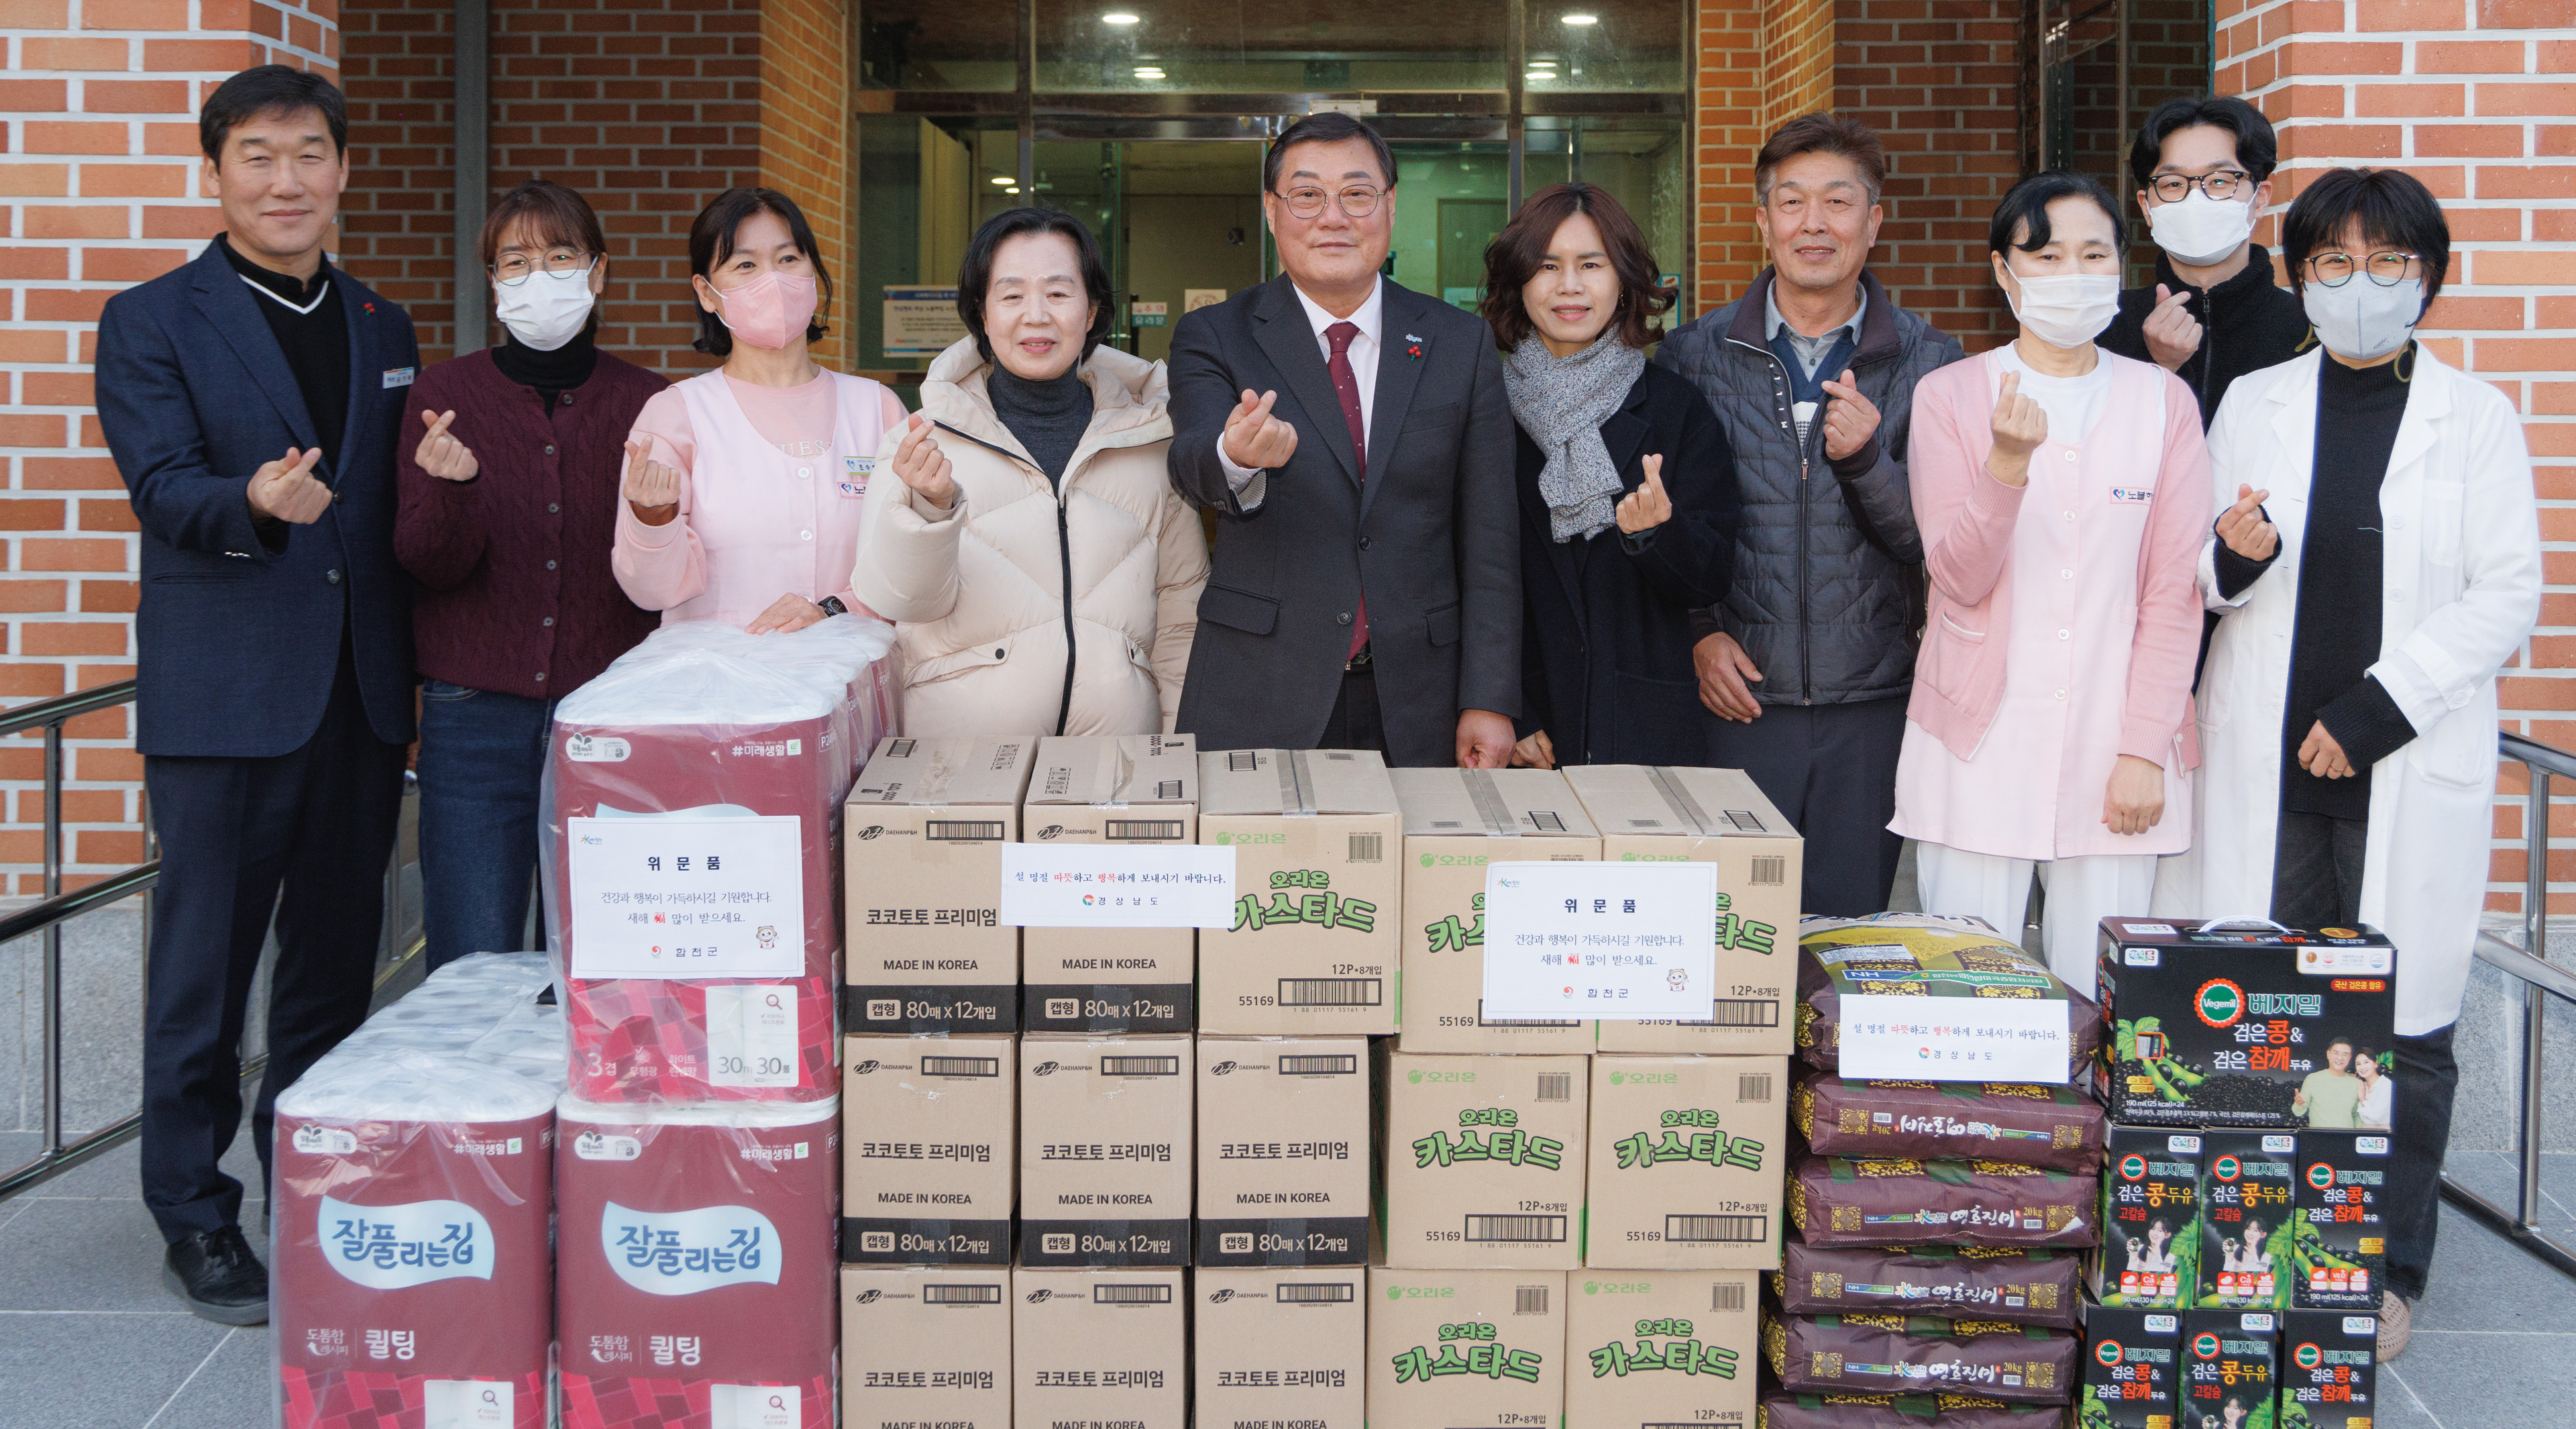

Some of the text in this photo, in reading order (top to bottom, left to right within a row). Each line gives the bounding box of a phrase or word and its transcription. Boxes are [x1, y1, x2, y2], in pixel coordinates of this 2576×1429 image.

[772, 440, 833, 457] UES
[732, 744, 784, 757] #미래생활
[1236, 833, 1287, 844] 오리온
[1440, 855, 1489, 865] 오리온
[1015, 871, 1226, 884] 설 명절 따뜻하고 행복하게 보내시기 바랍니다.
[1270, 869, 1330, 890] 오리온
[601, 892, 772, 904] 건강과 행복이 가득하시길 기원합니다.
[1098, 897, 1158, 906] 경상남도
[627, 912, 745, 924] 새해 福 많이 받으세요.
[867, 909, 996, 927] 코코토토 프리미엄
[1228, 891, 1377, 933] 카스타드
[1515, 934, 1684, 947] 건강과 행복이 가득하시길 기원합니다.
[676, 947, 718, 957] 합천군
[883, 960, 978, 969] MADE IN KOREA
[1541, 953, 1657, 966] 새해 福 많이 받으세요.
[1588, 988, 1628, 998] 합천군
[1239, 996, 1273, 1006] 55169
[2203, 998, 2236, 1009] Vegemil
[2248, 994, 2321, 1016] 베지밀
[872, 1003, 896, 1016] 캡형
[906, 1001, 940, 1019] 80매
[955, 1001, 996, 1020] 12개입
[1439, 1016, 1474, 1026] 55169
[1852, 1022, 2059, 1041] 설 명절 따뜻하고 행복하게 보내시기 바랍니다.
[668, 1055, 696, 1064] 화이트
[1933, 1049, 1993, 1061] 경상남도
[588, 1053, 616, 1077] 3겹
[630, 1067, 657, 1077] 무형광
[718, 1056, 753, 1074] 30m
[1426, 1071, 1477, 1083] 오리온
[1459, 1108, 1517, 1127] 오리온
[1660, 1109, 1719, 1128] 오리온
[1872, 1124, 1892, 1134] 20kg
[861, 1143, 990, 1162] 코코토토 프리미엄
[1219, 1142, 1348, 1161] 코코토토 프리미엄
[1413, 1130, 1564, 1171] 카스타드
[1614, 1130, 1764, 1171] 카스타드
[2149, 1162, 2194, 1177] 베지밀
[2243, 1163, 2288, 1177] 베지밀
[2337, 1171, 2382, 1185] 베지밀
[2023, 1207, 2043, 1218] 20kg
[2119, 1208, 2146, 1221] 고칼슘
[2214, 1208, 2241, 1222] 고칼슘
[1426, 1230, 1460, 1241] 55169
[332, 1218, 473, 1270] 잘풀리는집
[616, 1225, 760, 1276] 잘풀리는집
[2006, 1284, 2025, 1295] 20kg
[1438, 1322, 1497, 1341] 오리온
[1635, 1318, 1694, 1338] 오리온
[307, 1328, 345, 1344] 도톰함
[589, 1335, 629, 1351] 도톰함
[365, 1329, 415, 1359] 퀼팅
[649, 1335, 700, 1366] 퀼팅
[2222, 1340, 2268, 1354] 베지밀
[1589, 1339, 1739, 1380] 카스타드
[2125, 1348, 2170, 1362] 베지밀
[2323, 1351, 2369, 1364] 베지밀
[1392, 1343, 1542, 1383] 카스타드
[2003, 1363, 2022, 1373] 20kg
[1217, 1369, 1345, 1388] 코코토토 프리미엄
[2194, 1385, 2222, 1399] 고칼슘
